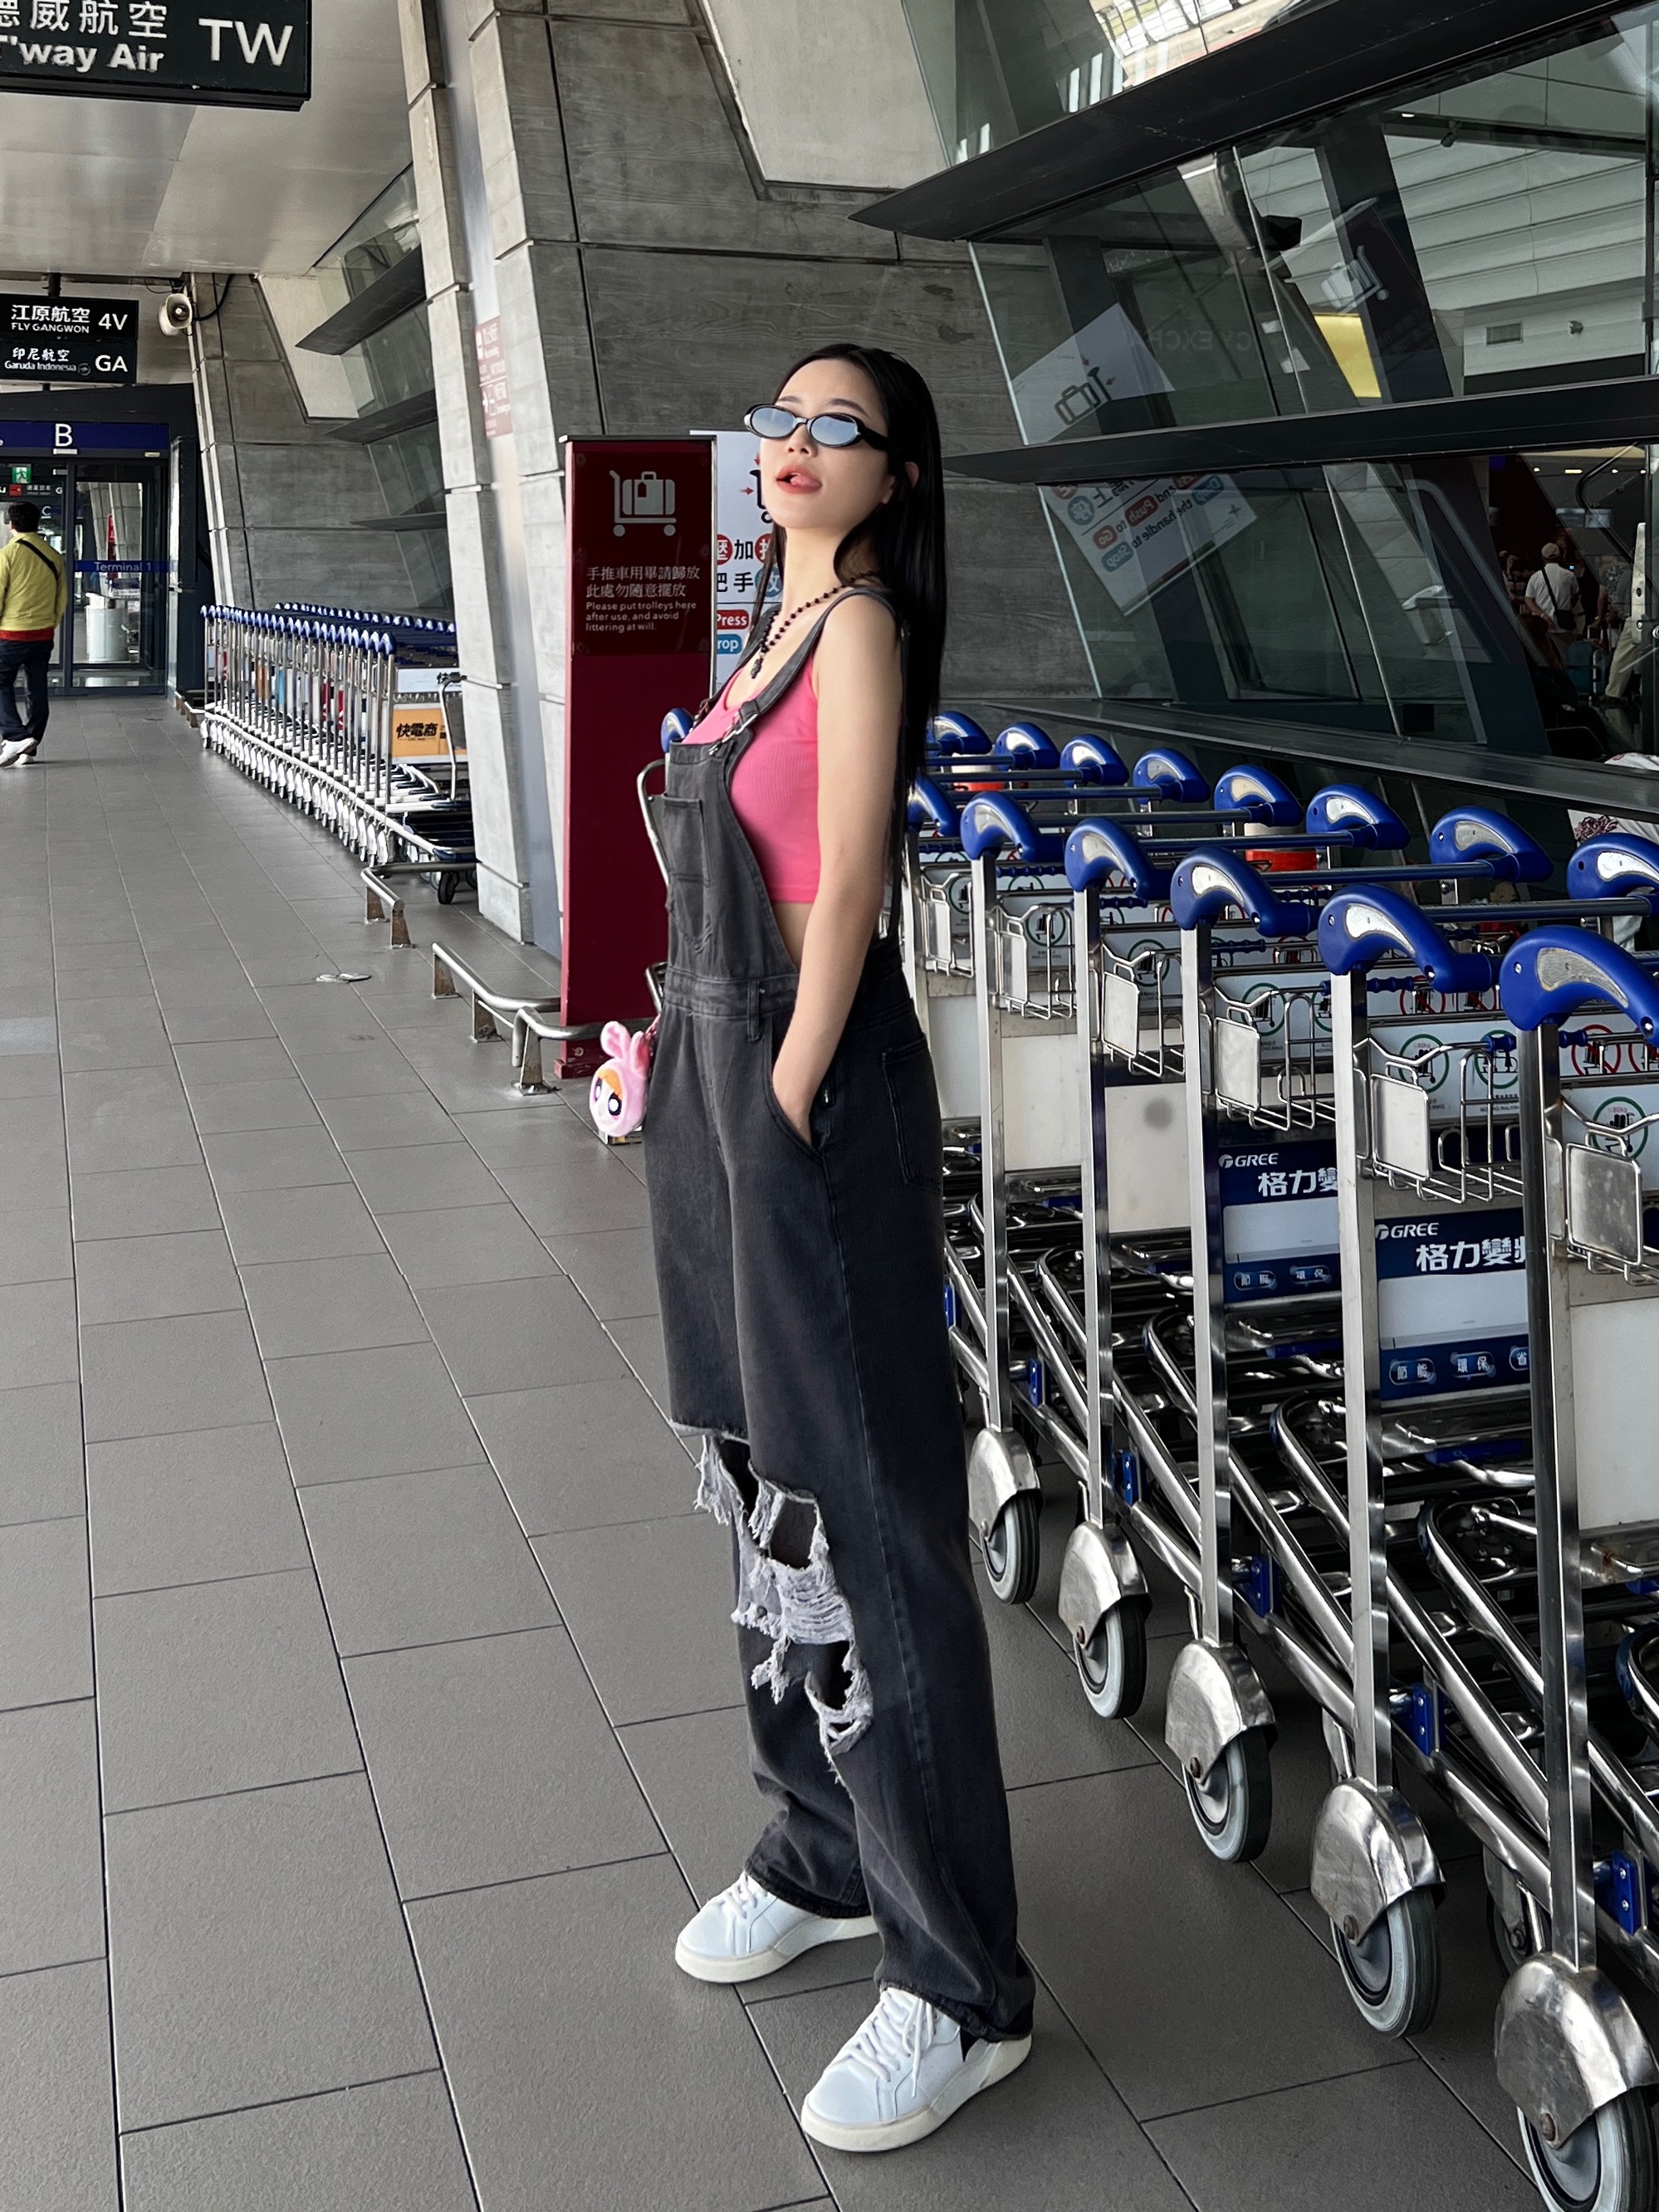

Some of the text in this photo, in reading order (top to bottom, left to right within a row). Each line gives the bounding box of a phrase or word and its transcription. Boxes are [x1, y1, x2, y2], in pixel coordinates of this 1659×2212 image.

[198, 18, 293, 66] TW
[108, 43, 164, 72] Air
[11, 304, 91, 323] 江原航空
[12, 322, 90, 334] FLY GANGWON
[98, 313, 128, 330] 4V
[12, 347, 71, 362] 印尼航空
[4, 360, 76, 372] Garuda Indonesia
[95, 355, 128, 372] GA
[55, 423, 73, 447] B
[93, 561, 151, 571] Terminal 1
[586, 565, 701, 580] 手推車用畢請歸放
[586, 583, 687, 598] 此處勿隨意擺放
[585, 600, 697, 612] Please put trolleys here
[585, 612, 608, 621] after
[632, 612, 650, 620] and
[652, 611, 678, 619] avoid
[585, 623, 624, 634] littering
[626, 623, 636, 631] at
[717, 639, 739, 653] rop
[396, 722, 438, 739] 快電商
[1235, 1152, 1280, 1167] GREE
[1257, 1167, 1338, 1197] 格力變
[1390, 1222, 1439, 1239] GREE
